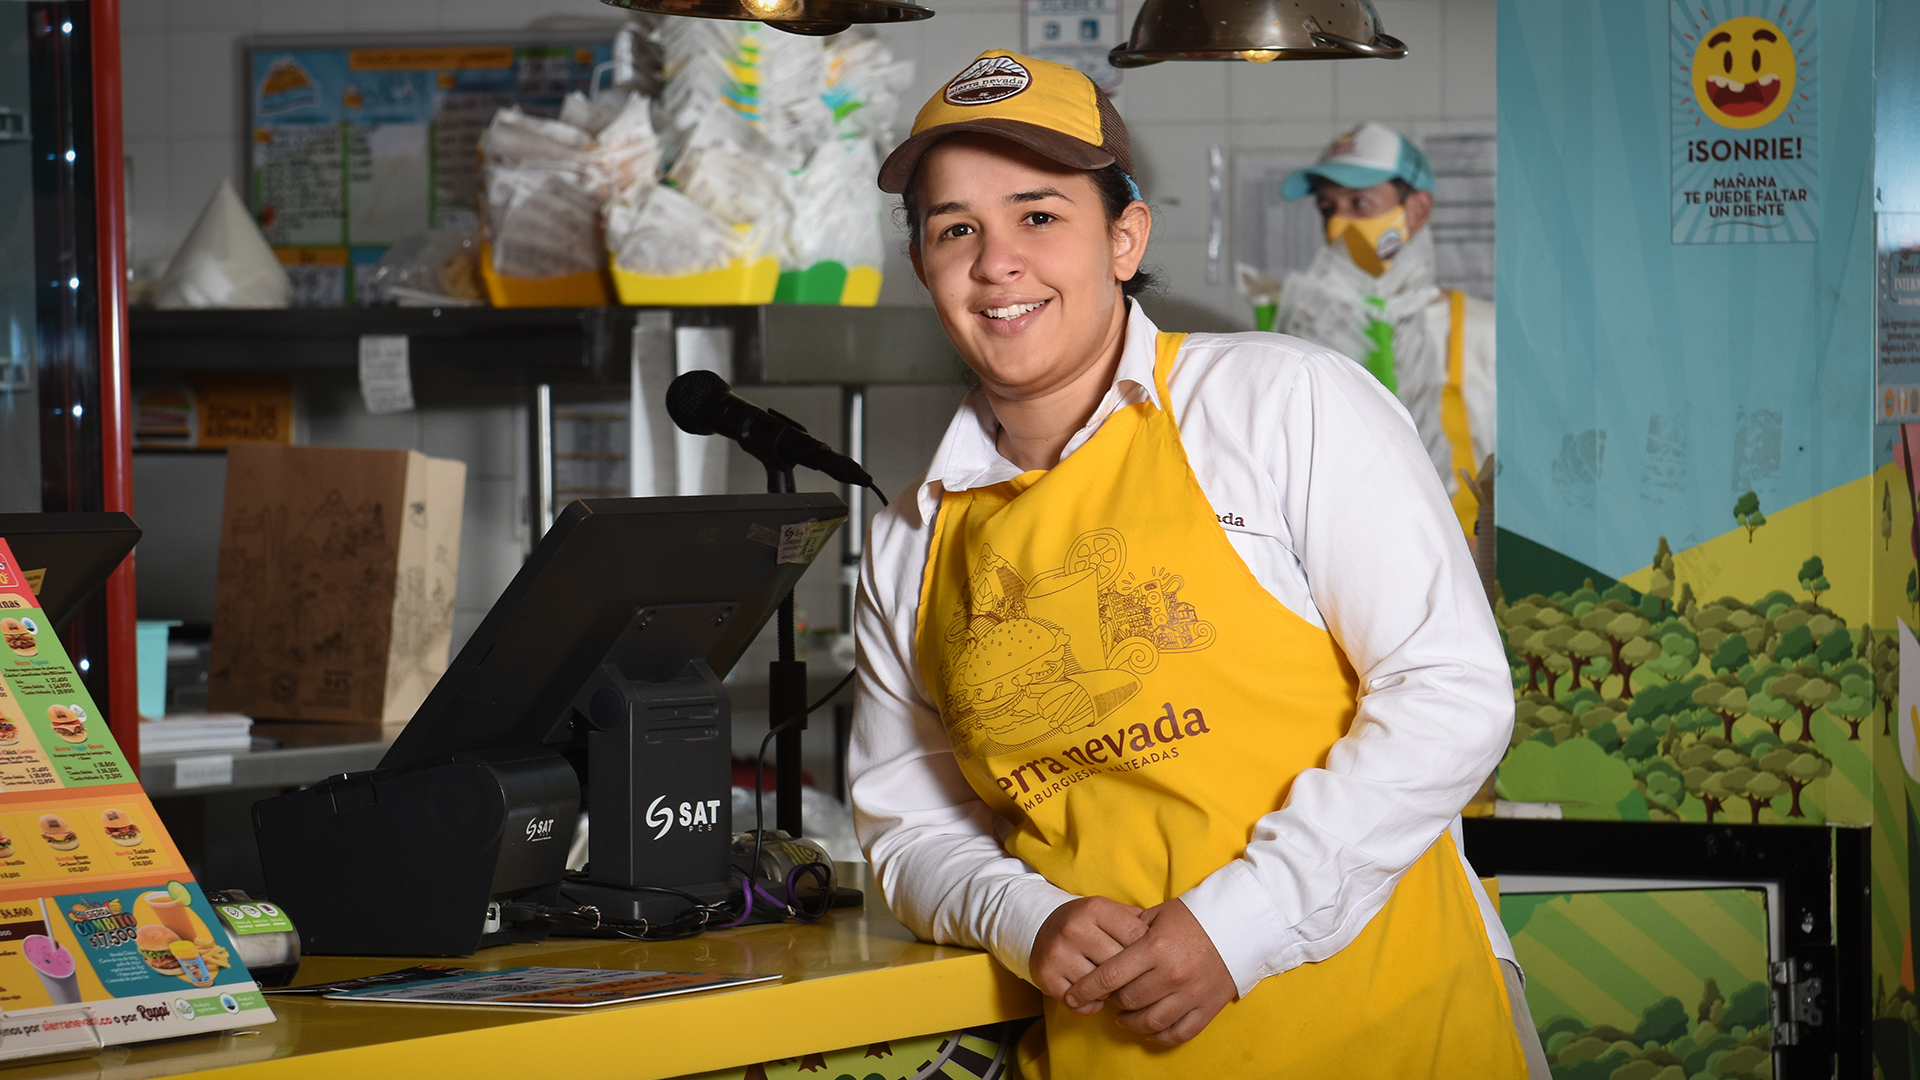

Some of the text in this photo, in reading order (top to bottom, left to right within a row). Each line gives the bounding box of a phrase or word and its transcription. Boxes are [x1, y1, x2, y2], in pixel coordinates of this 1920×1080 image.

[982, 77, 1024, 87] nevada
[1687, 138, 1802, 163] ¡SONRIE!
[1713, 173, 1777, 189] MAÑANA
[1684, 189, 1807, 204] TE PUEDE FALTAR
[1709, 204, 1785, 218] UN DIENTE
[1062, 702, 1210, 768] nevada
[1023, 767, 1102, 811] MBURGUESAS
[679, 800, 720, 827] SAT
[537, 819, 554, 834] SAT
[74, 913, 137, 936] COMBITO
[85, 908, 111, 919] SIERRA
[89, 927, 138, 949] $17.500
[23, 1024, 40, 1038] por
[121, 1013, 137, 1026] por
[137, 1002, 170, 1021] Rappi
